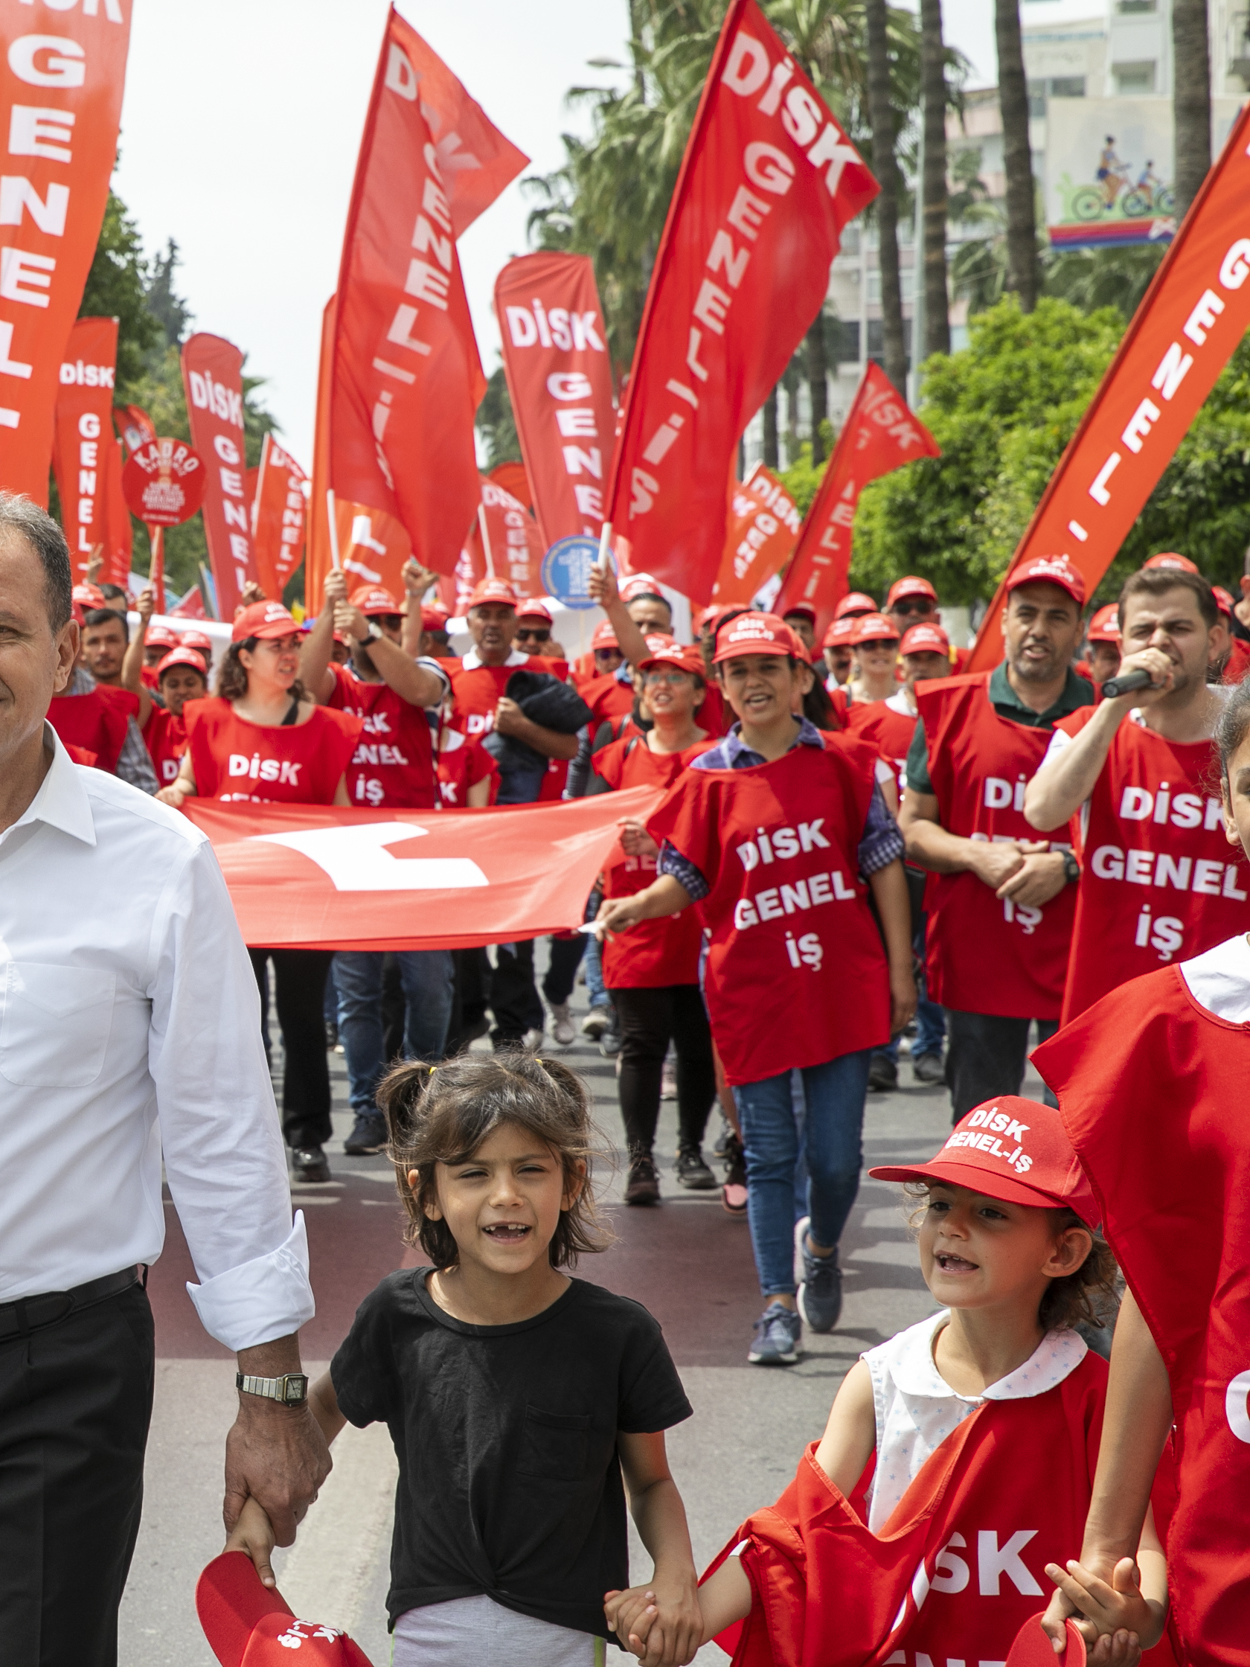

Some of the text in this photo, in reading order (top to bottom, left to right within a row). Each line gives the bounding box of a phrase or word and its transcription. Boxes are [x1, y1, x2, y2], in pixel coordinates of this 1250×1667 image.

[720, 31, 862, 198] DİSK
[505, 298, 606, 352] DİSK
[60, 361, 116, 389] DİSK
[188, 369, 245, 428] DİSK
[133, 441, 200, 475] KADRO
[736, 616, 766, 632] DİSK
[228, 752, 303, 786] DİSK
[355, 773, 385, 807] İŞ
[984, 773, 1027, 813] Dİ
[1119, 781, 1226, 832] DİSK
[736, 818, 831, 872] DİSK
[1091, 844, 1248, 902] GENEL
[734, 870, 857, 931] GENEL
[785, 930, 824, 972] İŞ
[1135, 904, 1184, 961] İŞ
[967, 1106, 1031, 1144] DİSK
[944, 1131, 1034, 1174] GENEL-İŞ
[927, 1529, 1045, 1598] SK
